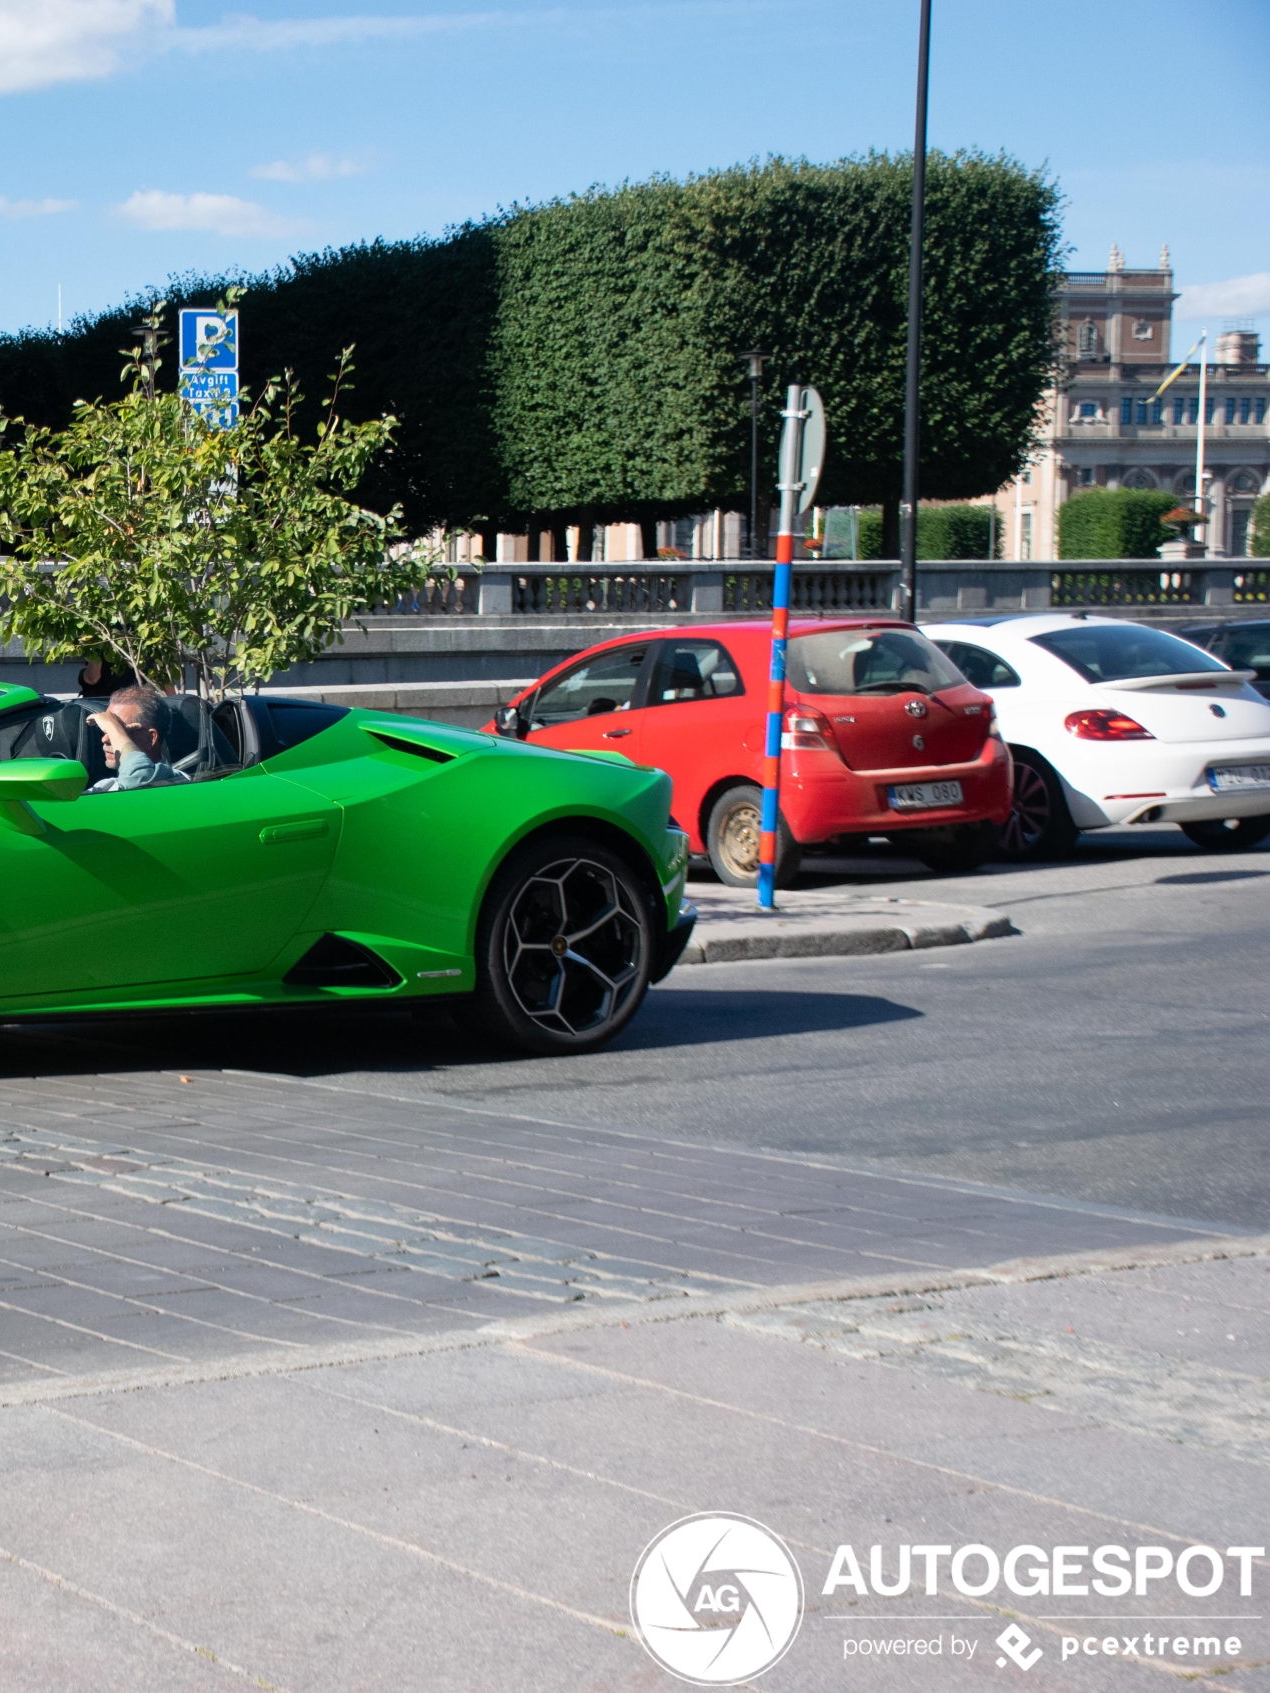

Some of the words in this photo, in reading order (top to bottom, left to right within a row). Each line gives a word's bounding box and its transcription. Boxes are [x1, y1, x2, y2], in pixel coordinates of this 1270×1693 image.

[196, 316, 227, 364] P
[190, 375, 228, 387] Avgift
[896, 787, 924, 802] KWS
[932, 783, 959, 801] 080
